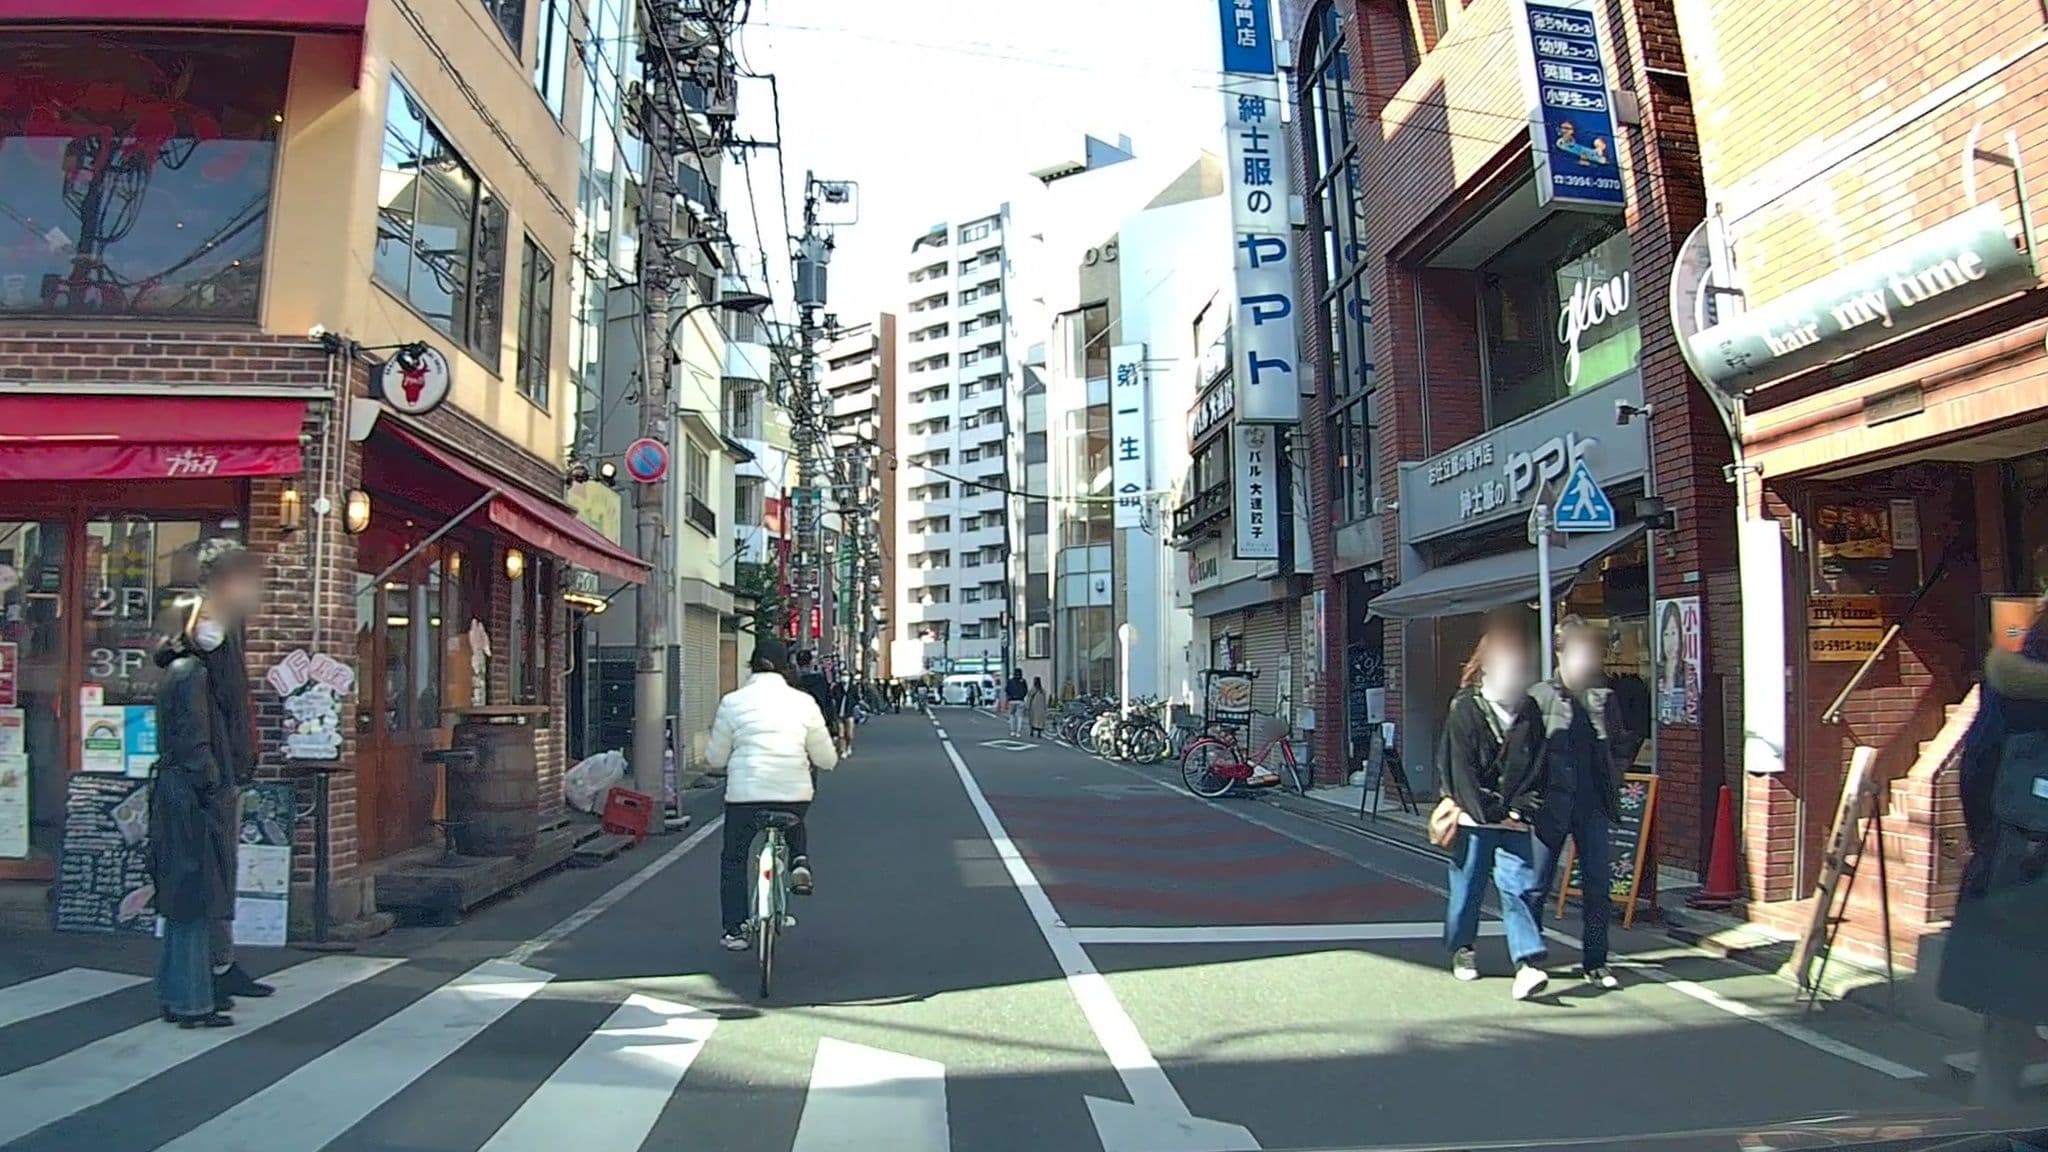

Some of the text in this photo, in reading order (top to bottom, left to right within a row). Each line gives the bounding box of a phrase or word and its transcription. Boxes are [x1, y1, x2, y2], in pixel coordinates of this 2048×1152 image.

[1538, 38, 1596, 59] 幼児コース
[1543, 63, 1600, 84] 英語コース
[1547, 89, 1604, 109] 小学生コース
[1238, 93, 1292, 385] 紳士服の ヤマト
[1829, 288, 1893, 328] my
[1558, 270, 1630, 386] glow
[1117, 363, 1142, 508] 第一生命
[1460, 480, 1505, 519] 紳士服の
[91, 586, 148, 616] 2F
[1683, 605, 1698, 660] 小川
[90, 647, 146, 677] 3F
